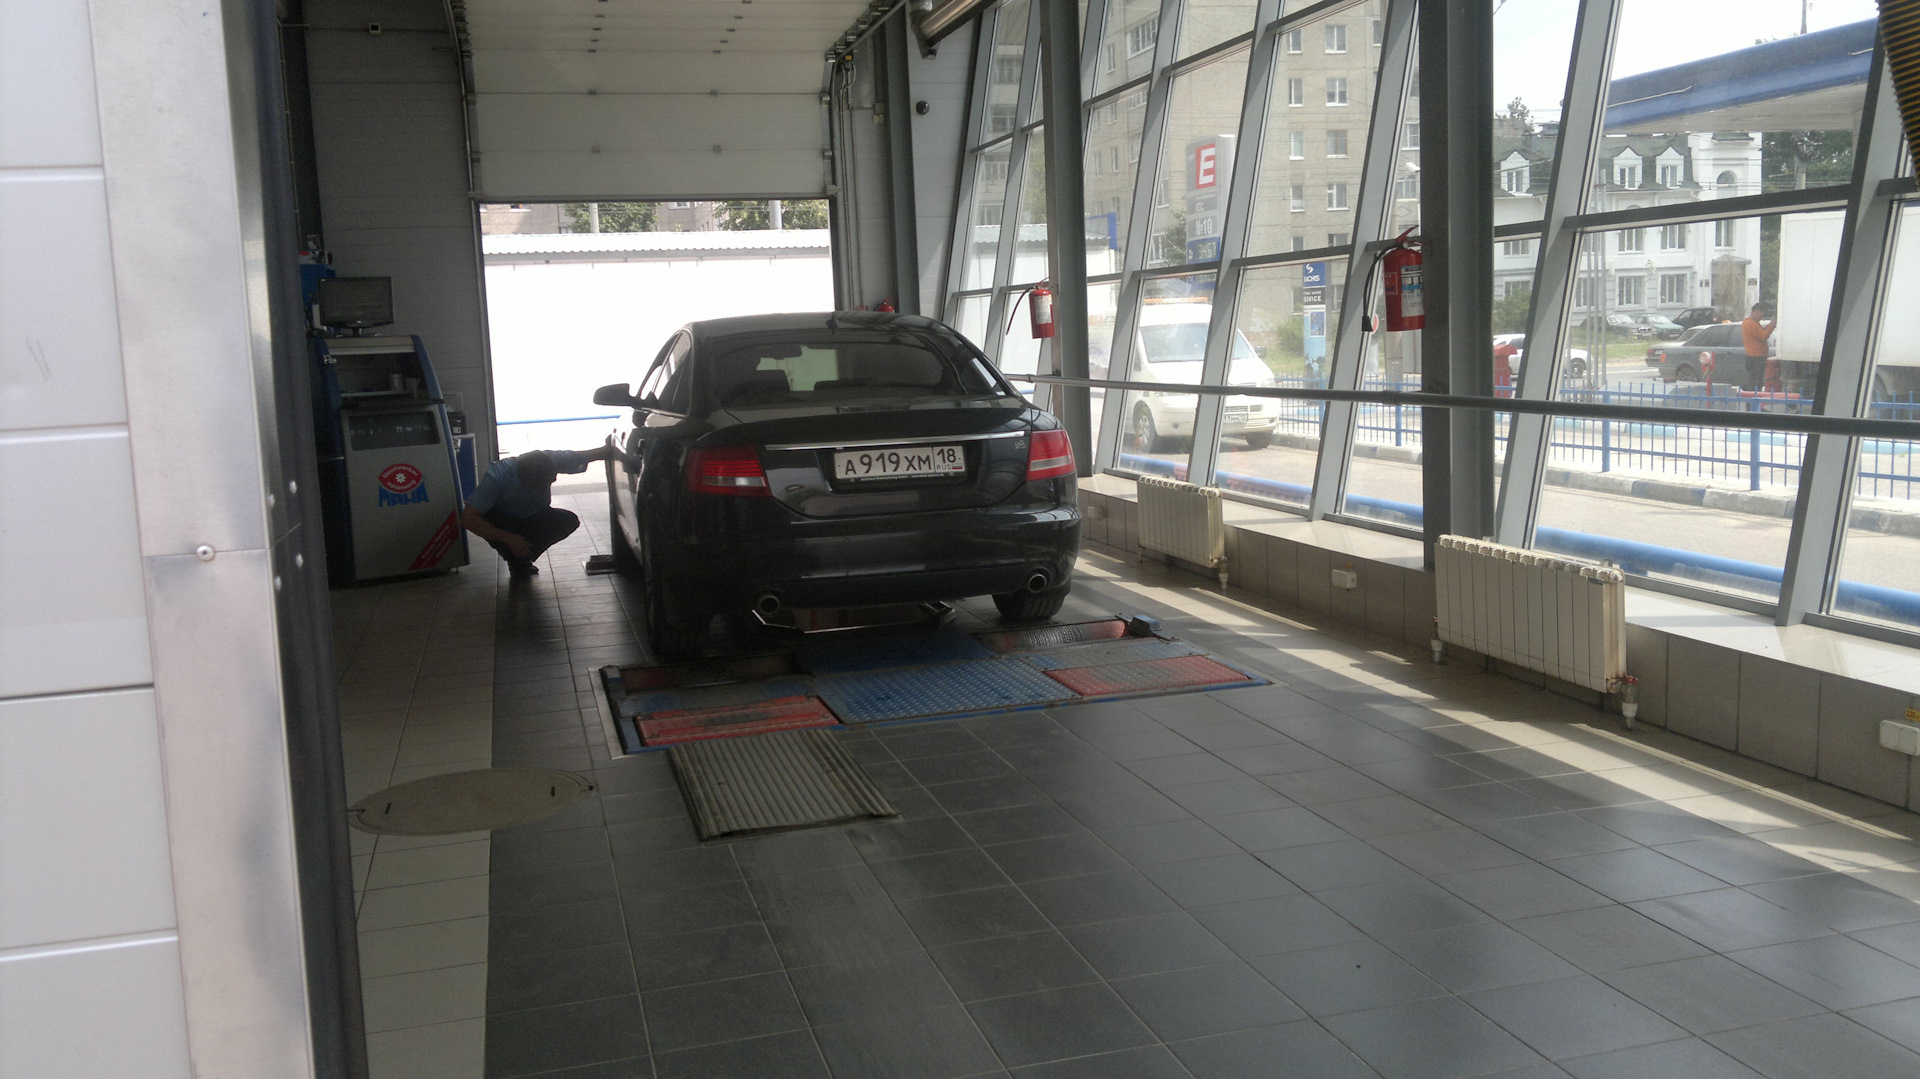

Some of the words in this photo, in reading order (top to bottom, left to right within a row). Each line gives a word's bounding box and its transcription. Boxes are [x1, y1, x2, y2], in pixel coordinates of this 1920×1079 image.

[1199, 147, 1215, 185] E
[936, 448, 957, 463] 18
[378, 482, 429, 507] MAHA
